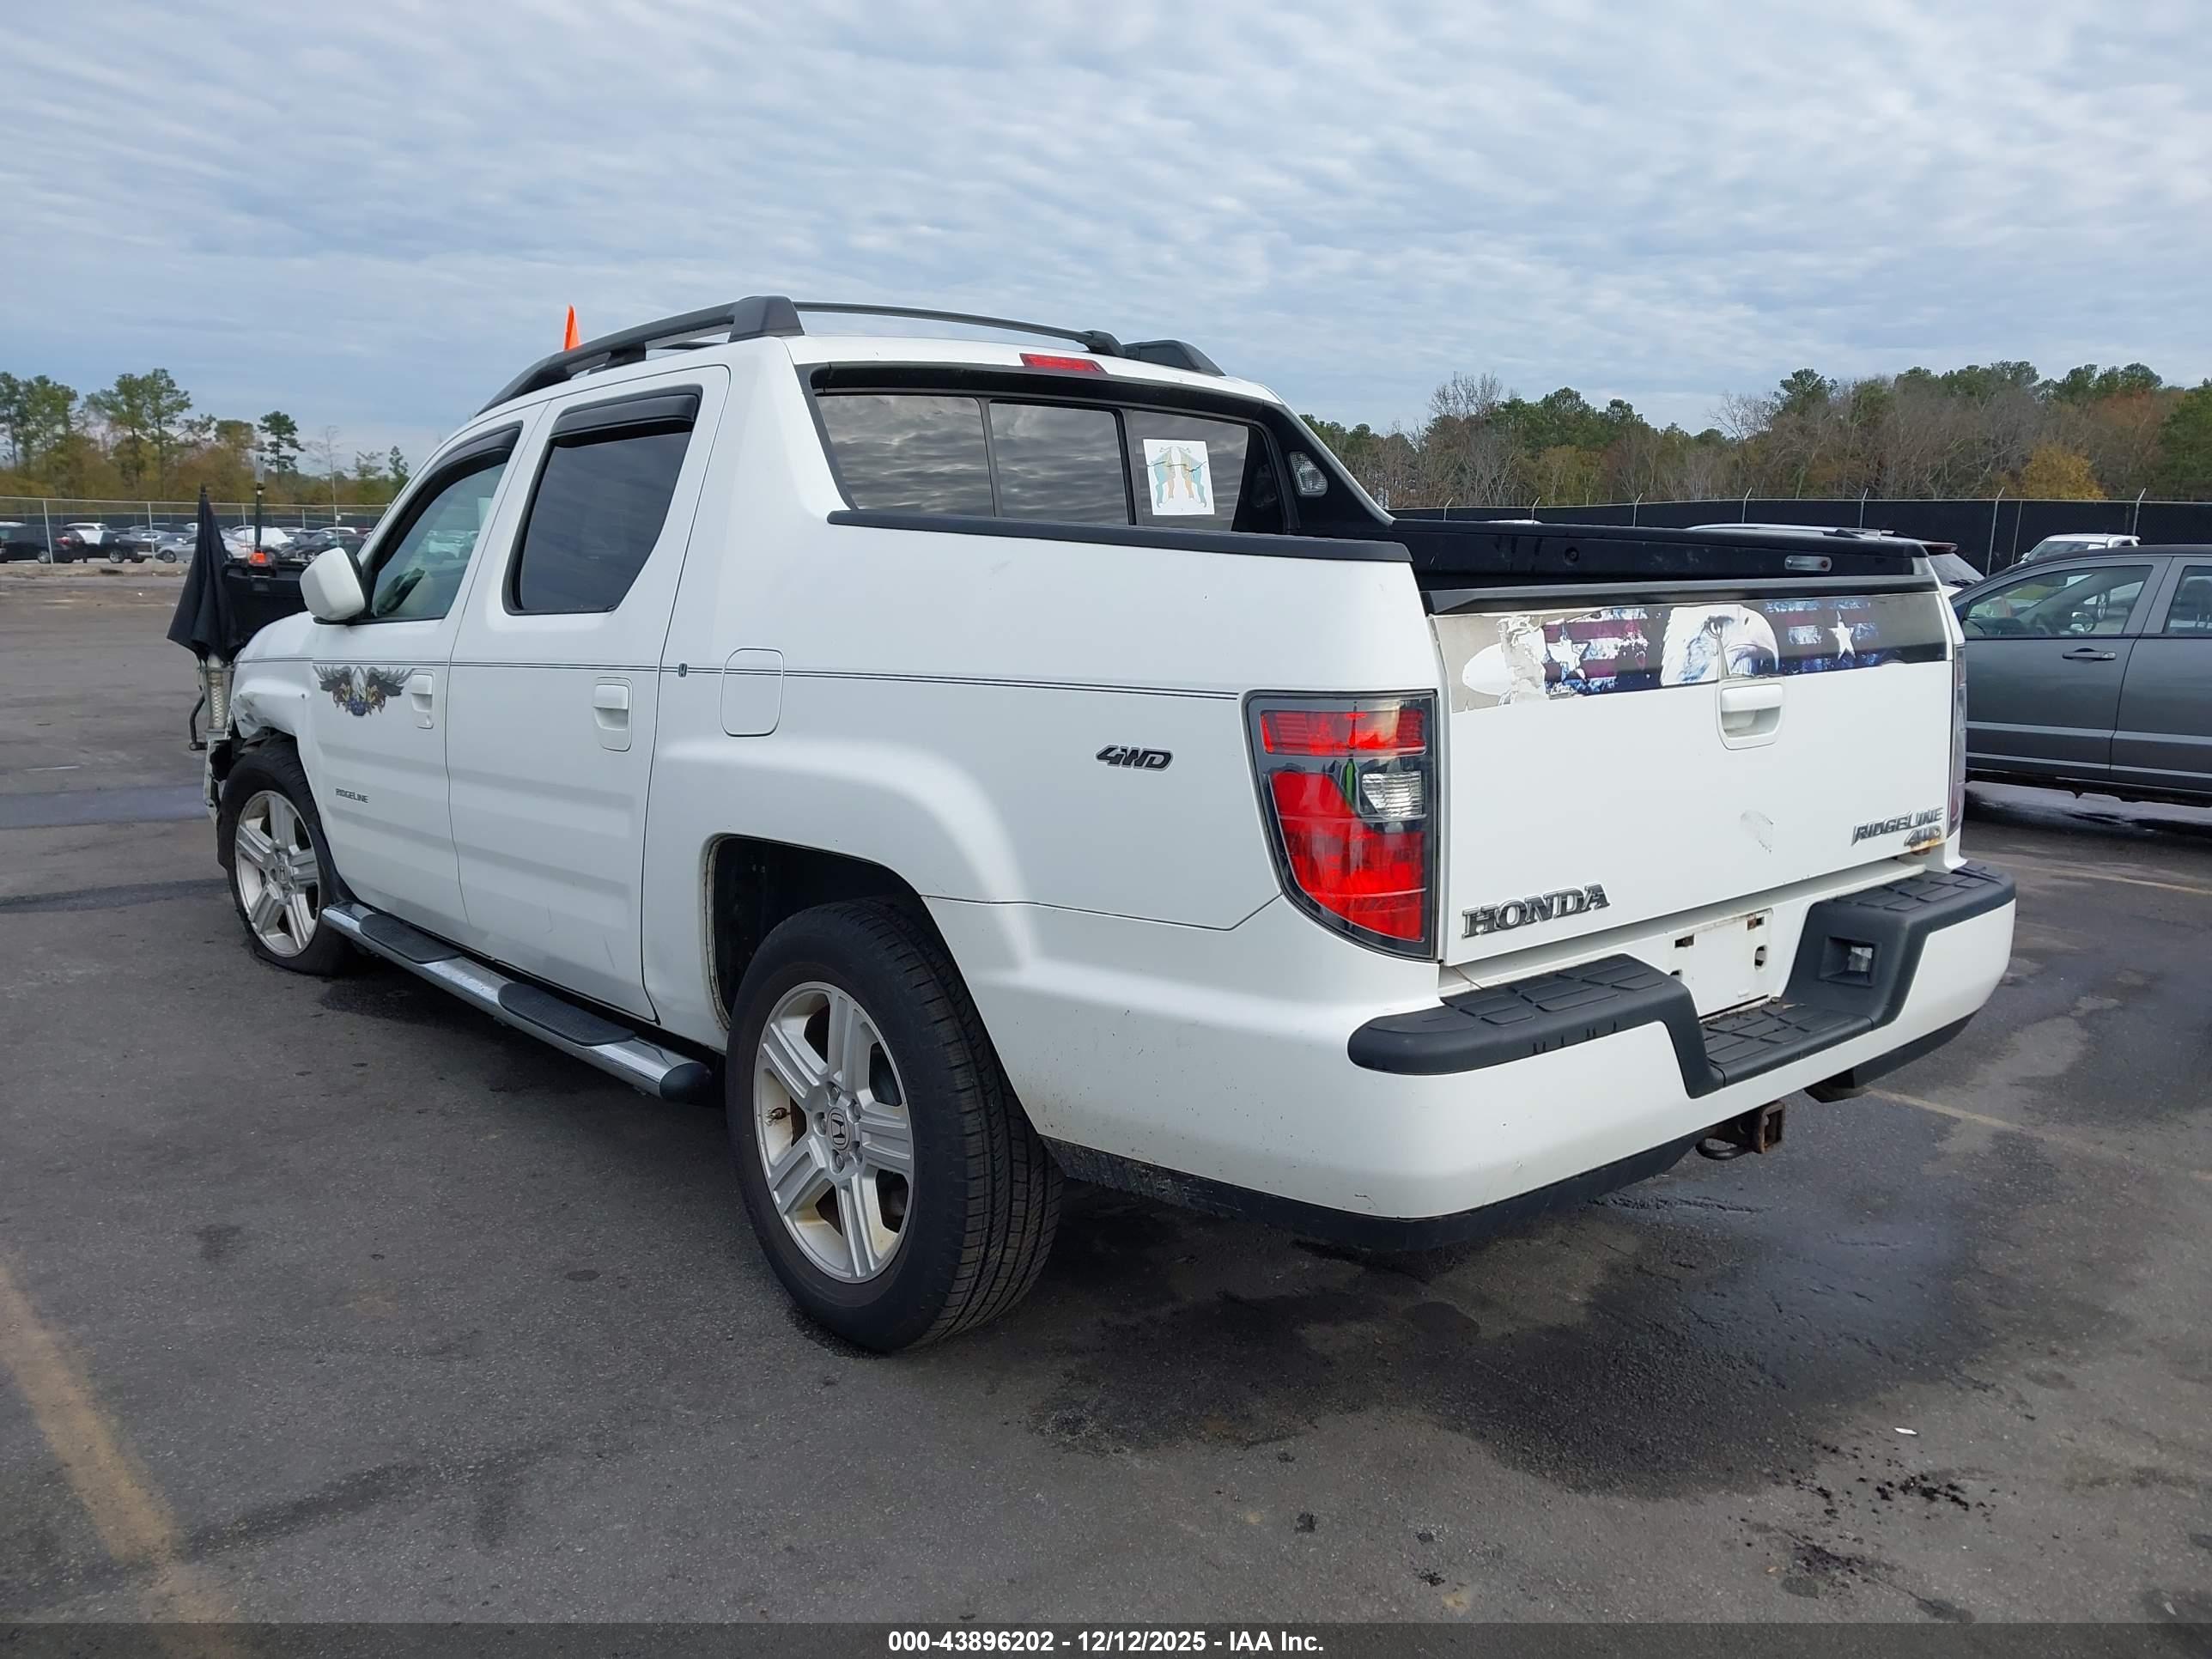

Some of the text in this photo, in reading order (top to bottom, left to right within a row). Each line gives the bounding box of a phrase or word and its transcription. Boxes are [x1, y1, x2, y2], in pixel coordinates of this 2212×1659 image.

[1096, 744, 1174, 771] 4WD
[336, 787, 369, 803] RIDGELINE
[1850, 806, 1943, 846] RIDGELINE
[1462, 883, 1610, 939] HONDA
